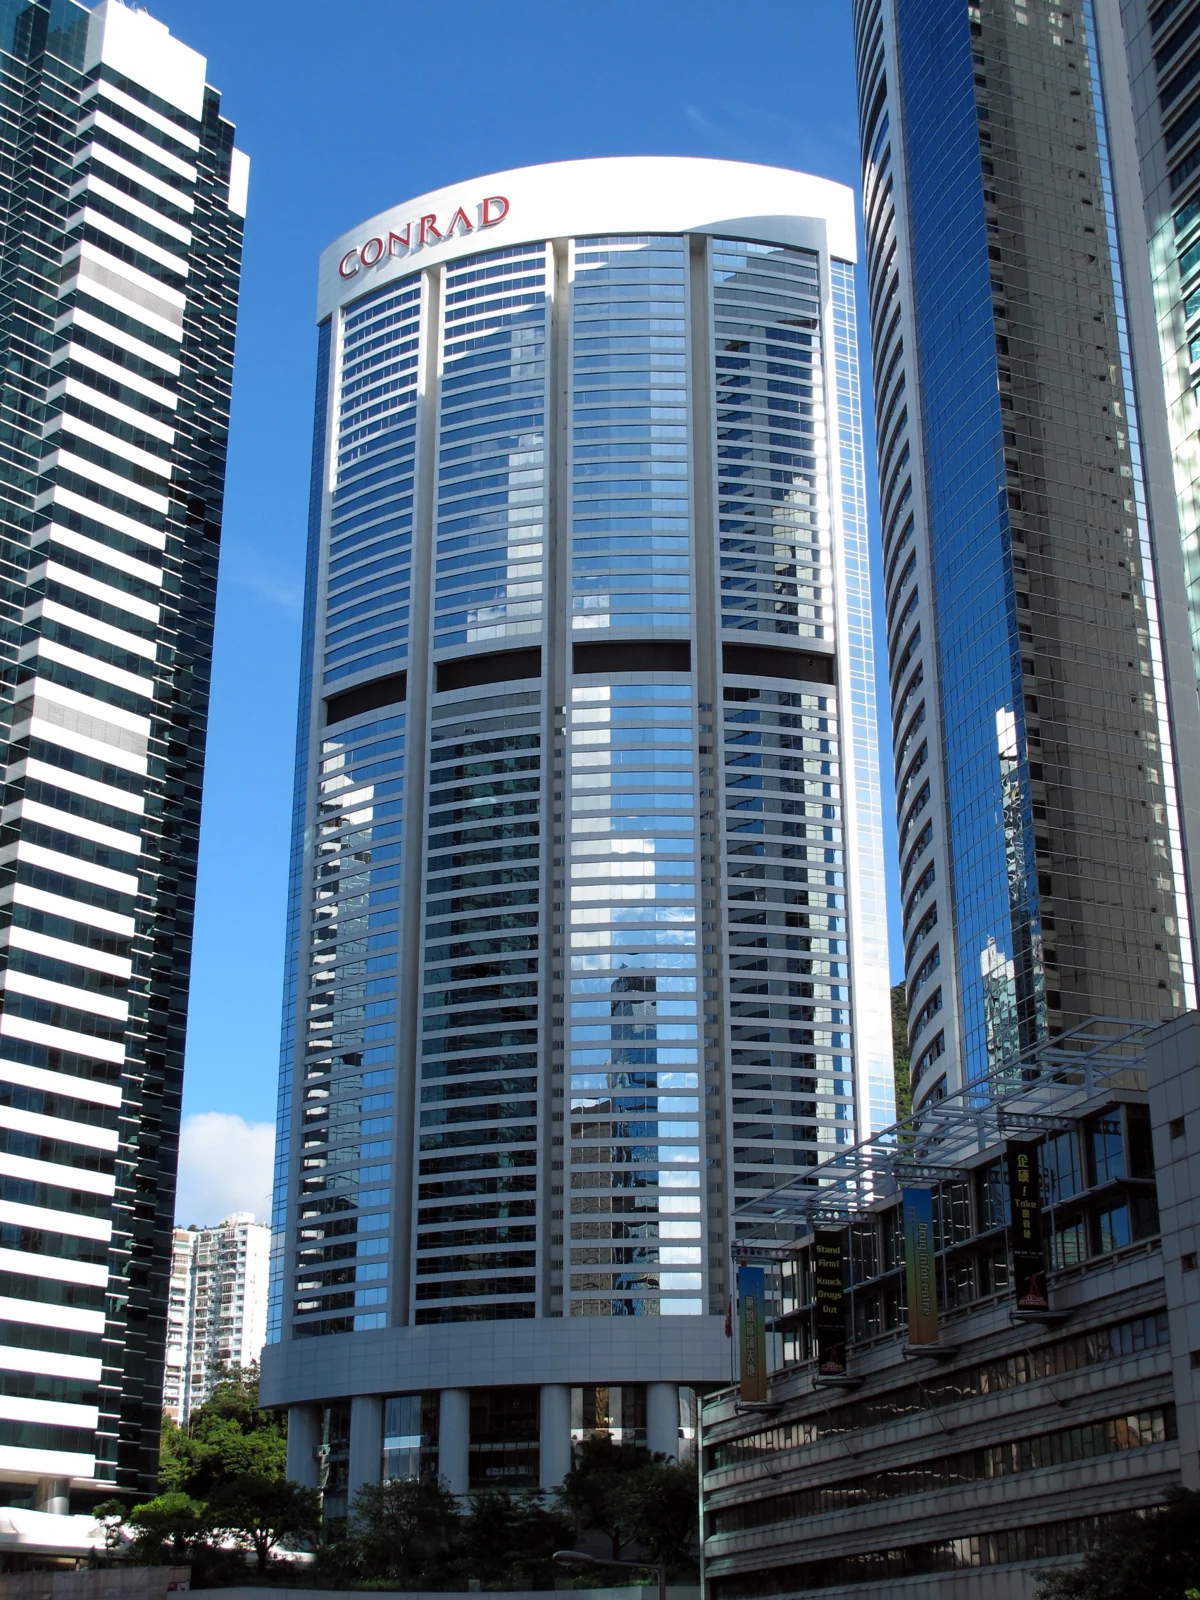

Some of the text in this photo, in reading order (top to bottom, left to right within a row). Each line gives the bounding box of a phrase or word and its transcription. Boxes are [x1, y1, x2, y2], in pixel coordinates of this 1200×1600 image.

[338, 195, 510, 279] CONRAD
[1015, 1199, 1037, 1209] Take
[816, 1245, 841, 1254] Stand
[818, 1259, 840, 1268] Firm!
[917, 1222, 932, 1316] Drug InfoCentre
[816, 1277, 842, 1286] Knock
[818, 1290, 842, 1300] Drugs
[822, 1305, 838, 1314] Out
